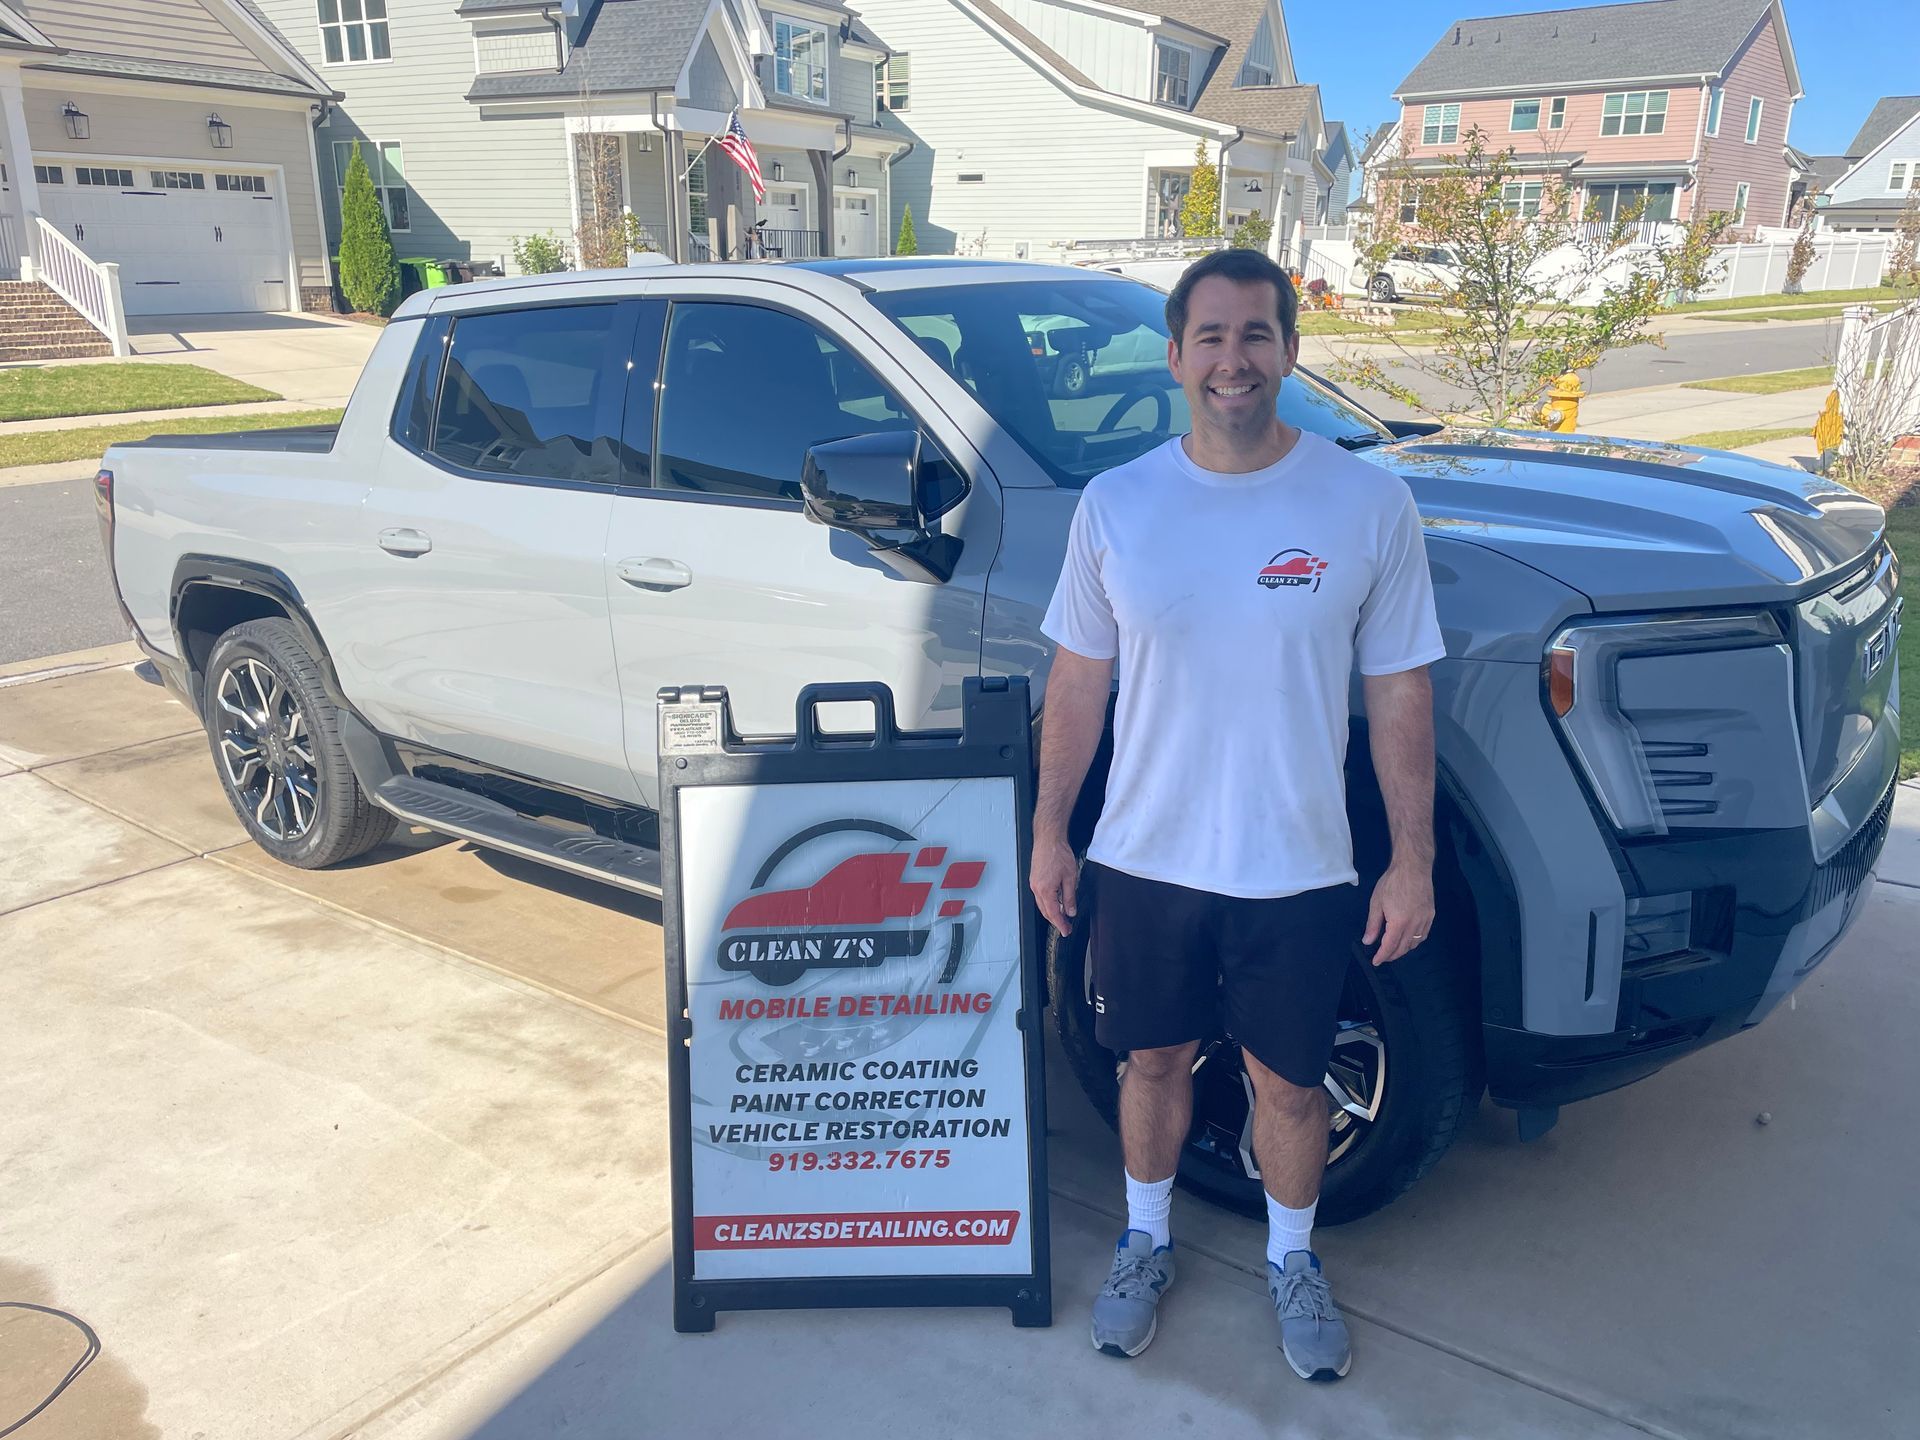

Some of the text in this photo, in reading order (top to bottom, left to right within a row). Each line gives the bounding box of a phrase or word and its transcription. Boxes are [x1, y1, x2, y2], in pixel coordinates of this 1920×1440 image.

[727, 937, 875, 962] CLEAN Z'S
[719, 992, 993, 1020] MOBILE DETAILING
[735, 1059, 979, 1083] CERAMIC COATING
[730, 1088, 986, 1113] PAINT CORRECTION
[709, 1118, 1011, 1144] VEHICLE RESTORATION
[768, 1149, 952, 1173] 919.332.7675
[713, 1219, 1010, 1243] CLEANZSDETAILING.COM
